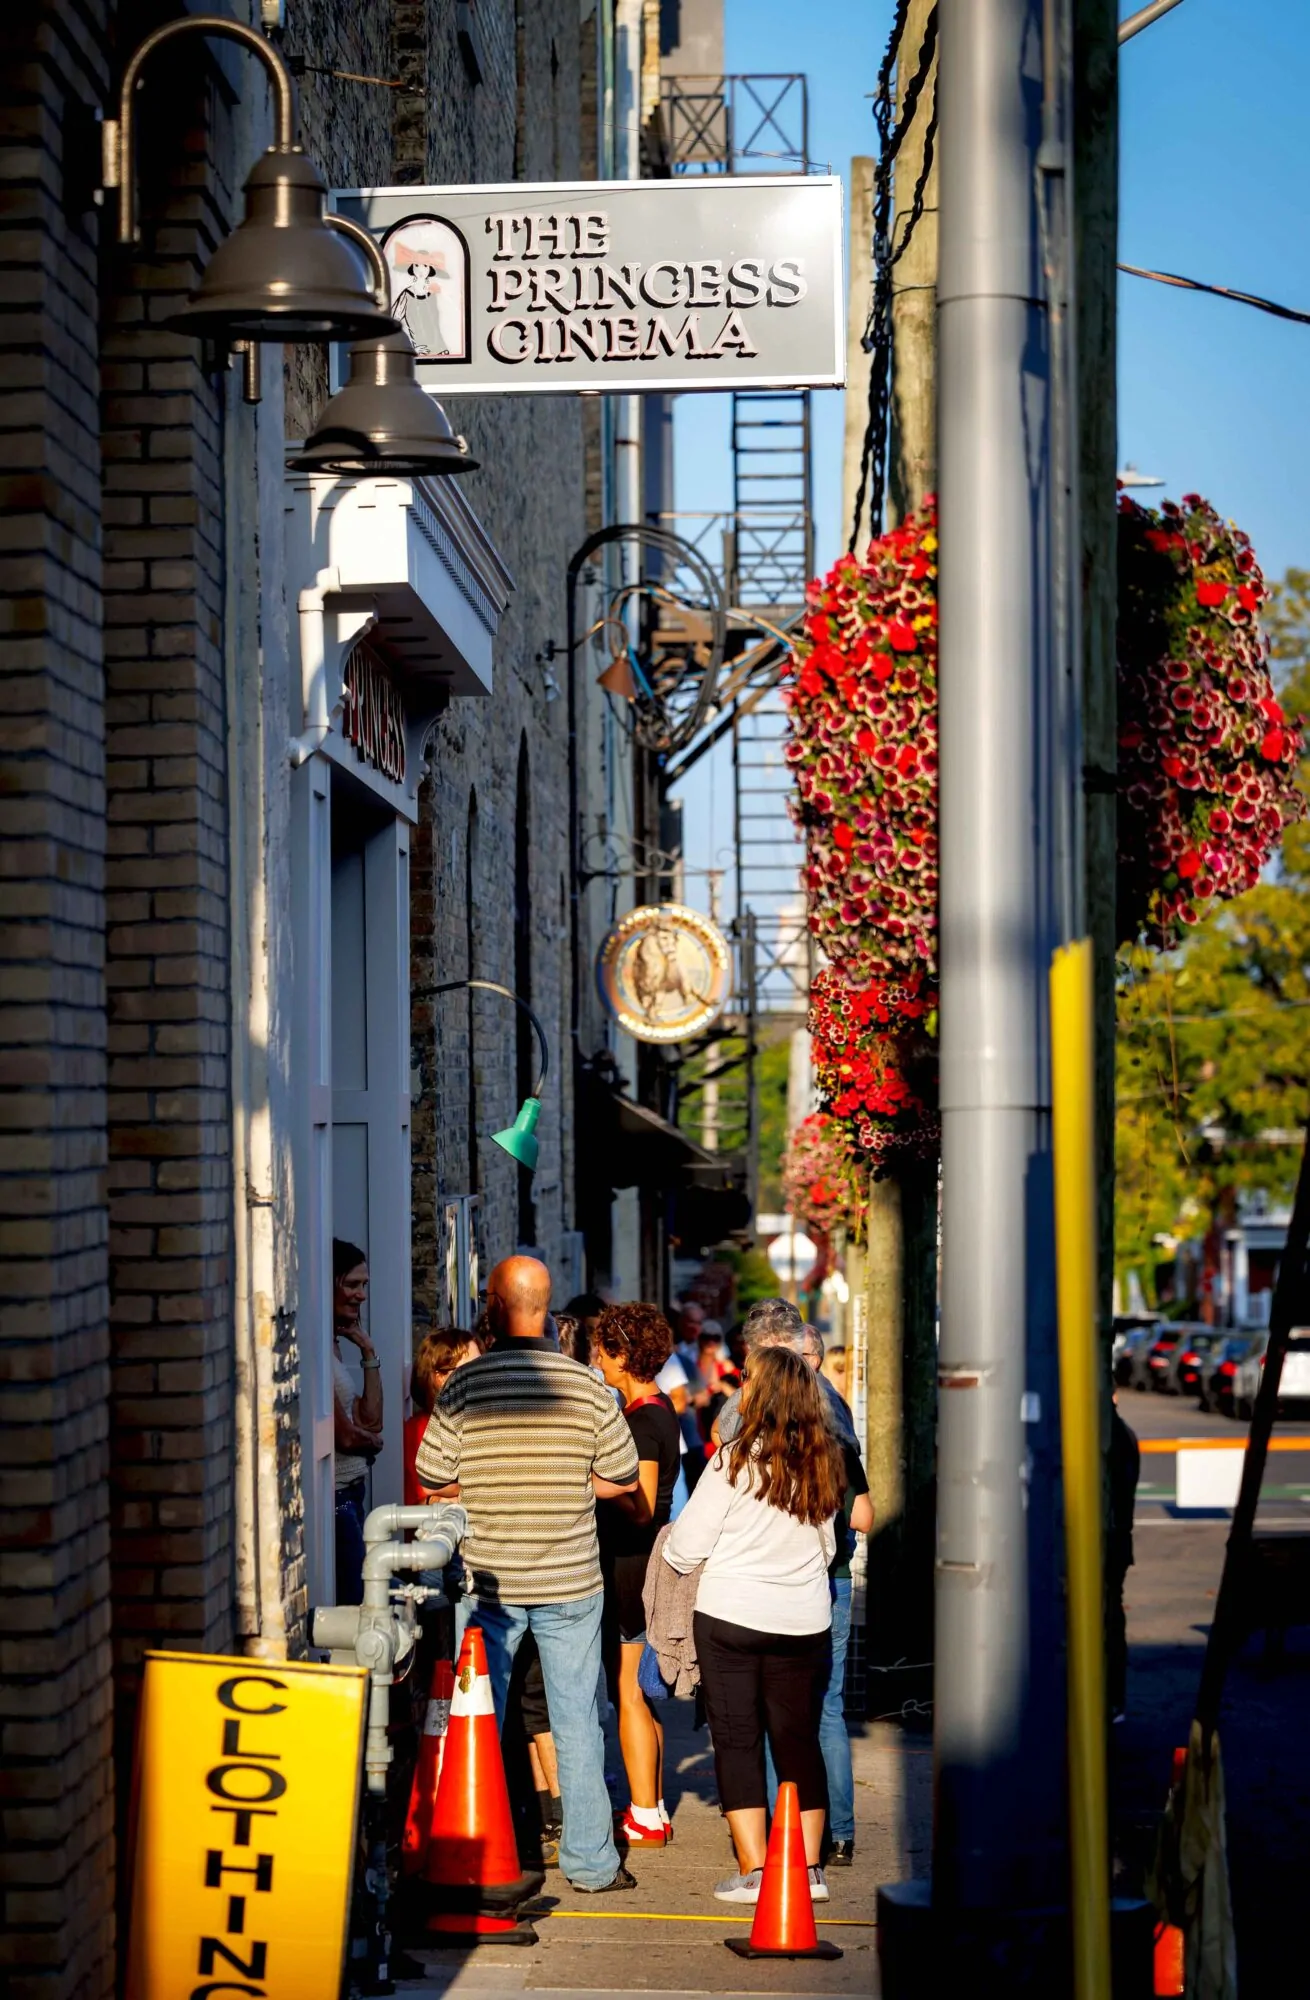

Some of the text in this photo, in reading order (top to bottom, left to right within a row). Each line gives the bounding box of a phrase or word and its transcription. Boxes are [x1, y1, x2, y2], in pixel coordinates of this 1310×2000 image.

[485, 210, 611, 260] THE
[486, 258, 809, 313] PRINCESS
[486, 308, 759, 364] CINEMA
[343, 646, 406, 785] PRINCESS
